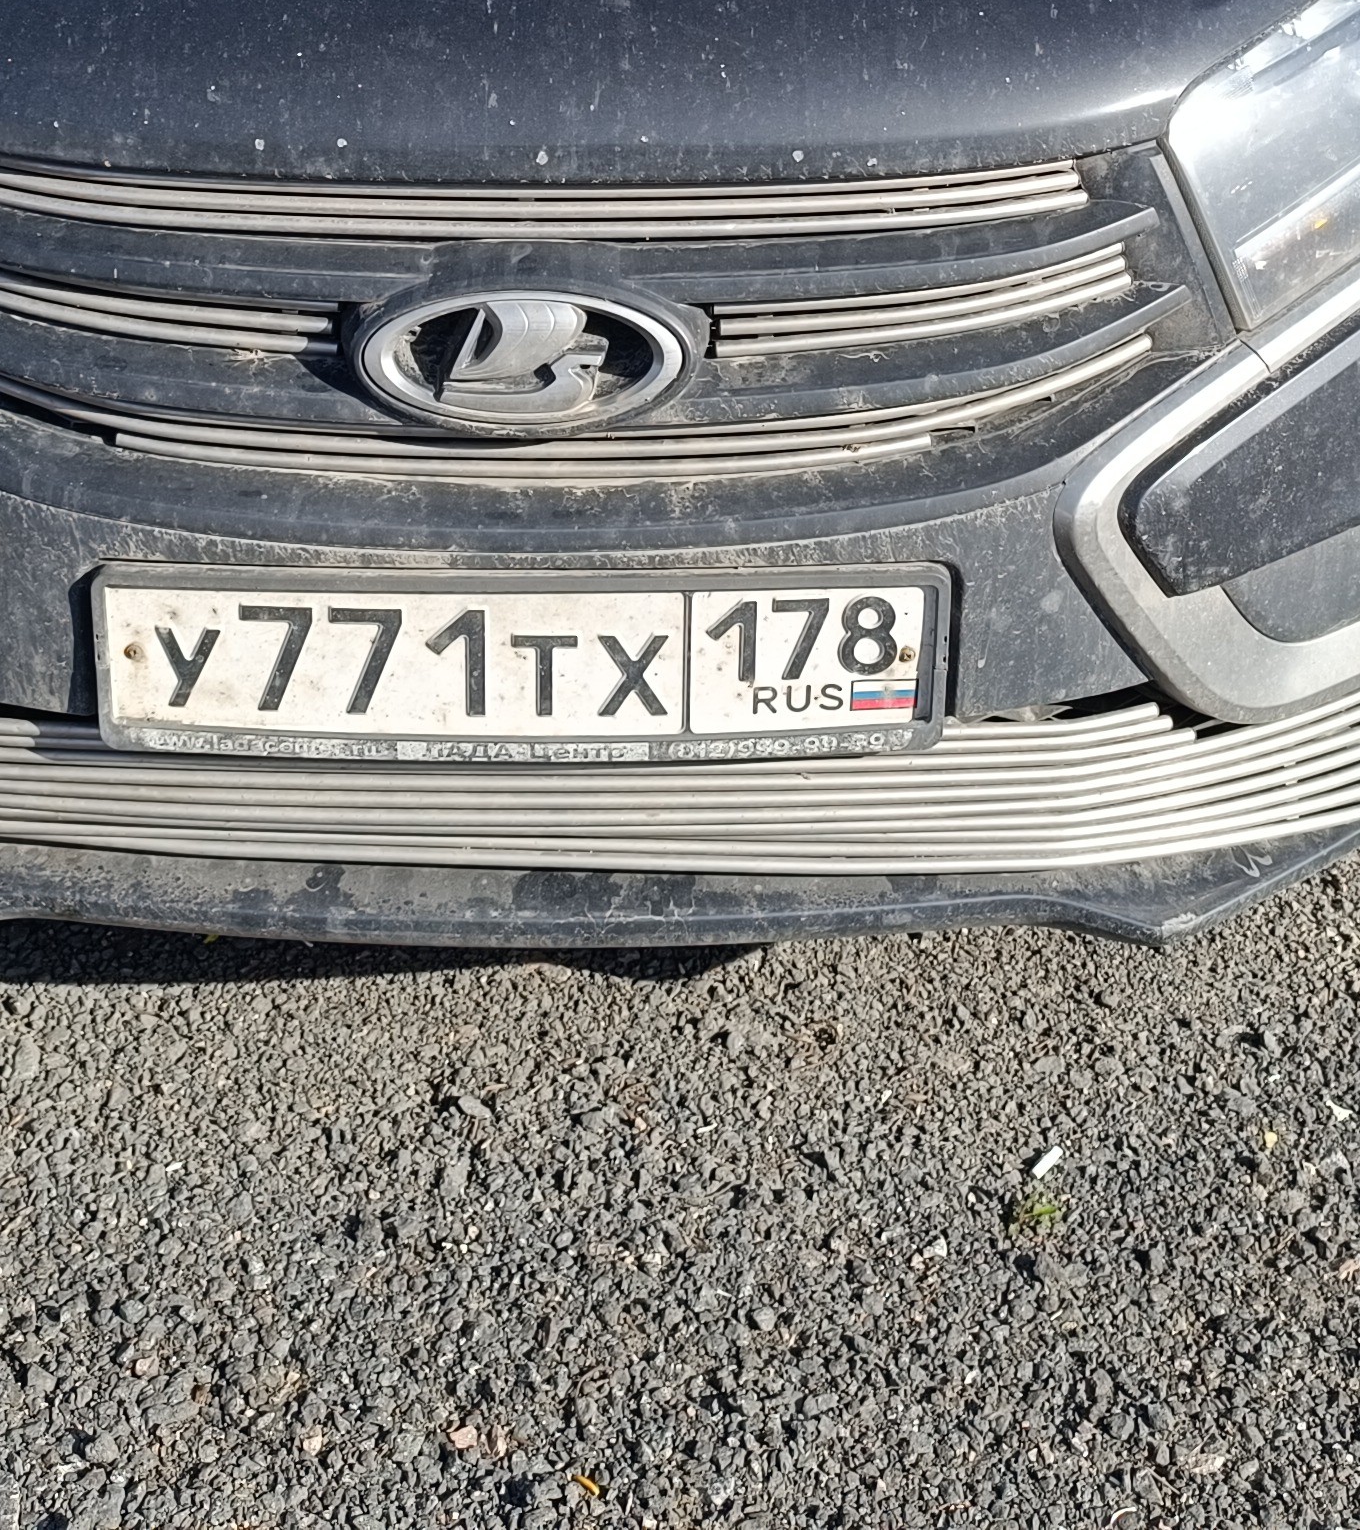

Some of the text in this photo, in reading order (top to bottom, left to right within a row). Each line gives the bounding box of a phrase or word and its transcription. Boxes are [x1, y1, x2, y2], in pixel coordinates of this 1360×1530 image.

[154, 594, 898, 717] У771ТХ 178
[752, 683, 844, 714] RUS
